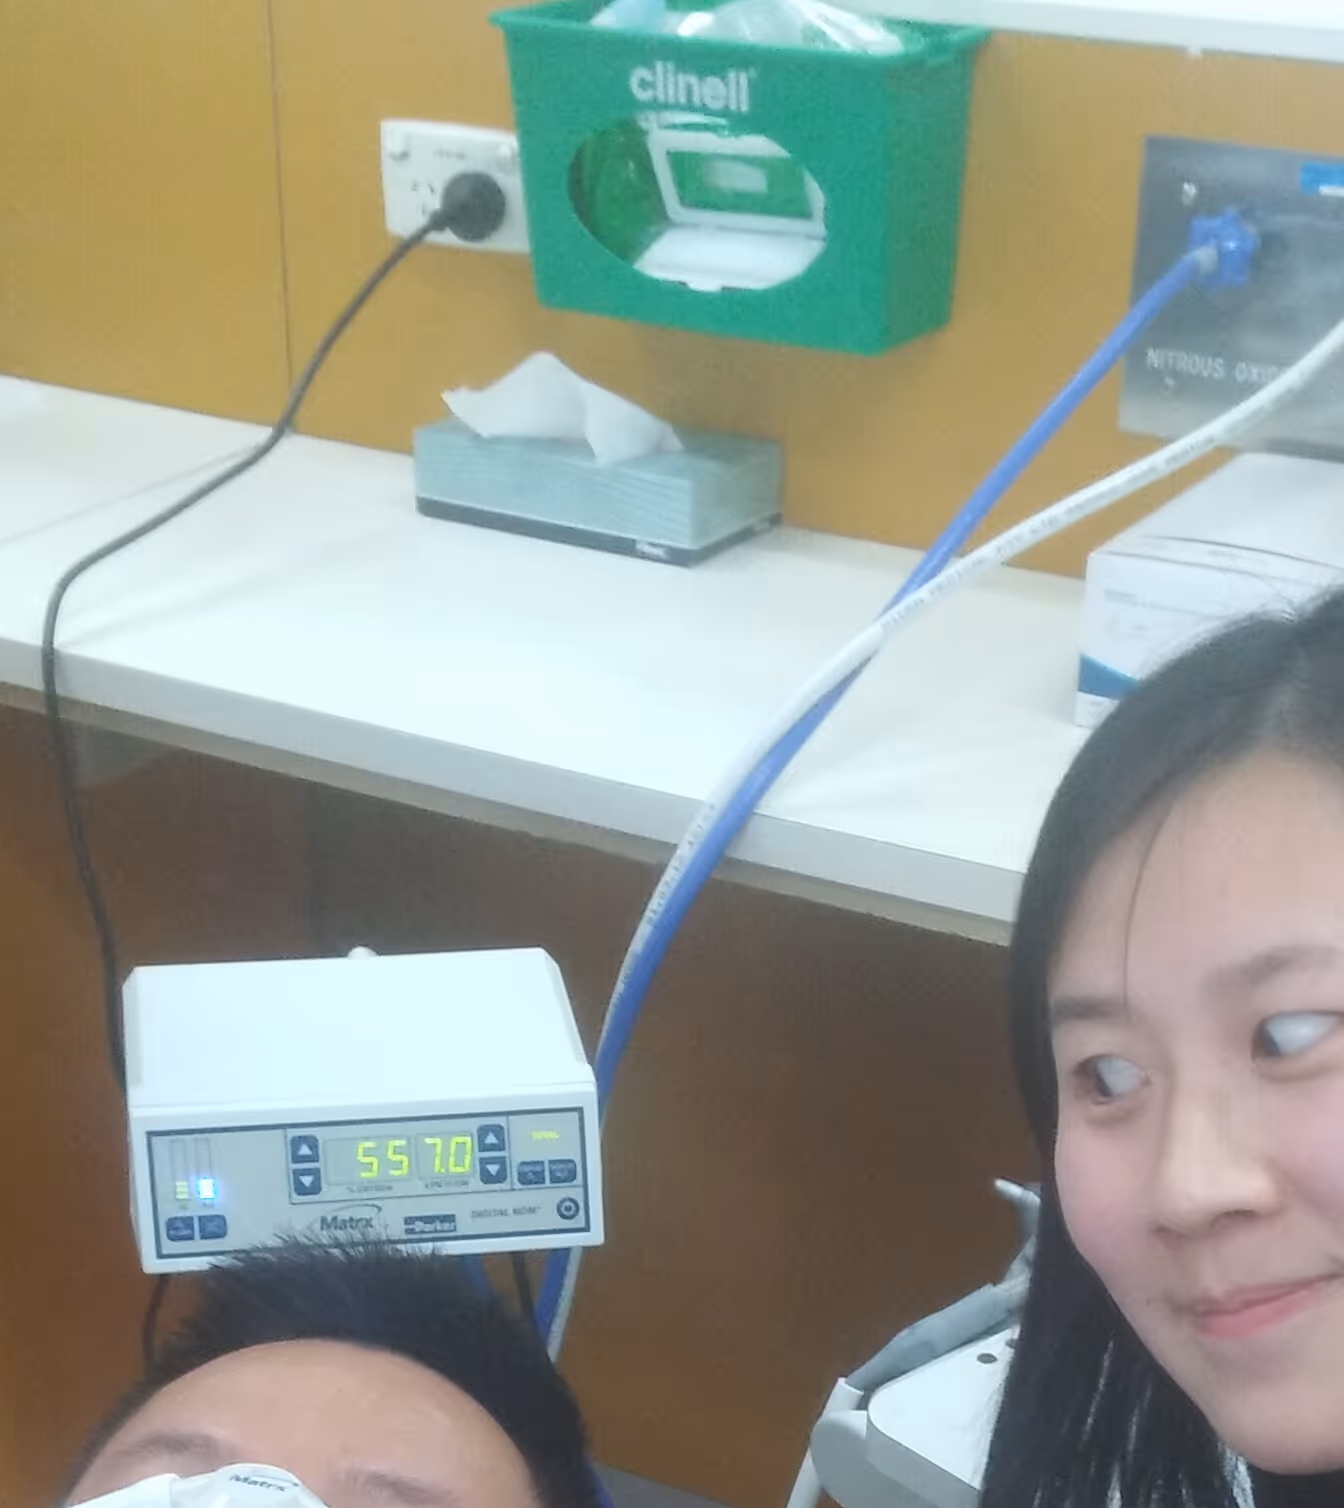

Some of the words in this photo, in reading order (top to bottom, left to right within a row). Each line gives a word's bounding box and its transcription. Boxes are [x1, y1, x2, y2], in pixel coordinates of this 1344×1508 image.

[630, 60, 750, 113] clinell
[1147, 347, 1224, 379] NITROUS
[1235, 360, 1283, 384] OXID
[320, 1213, 375, 1232] Matrx
[413, 1219, 456, 1234] Parker
